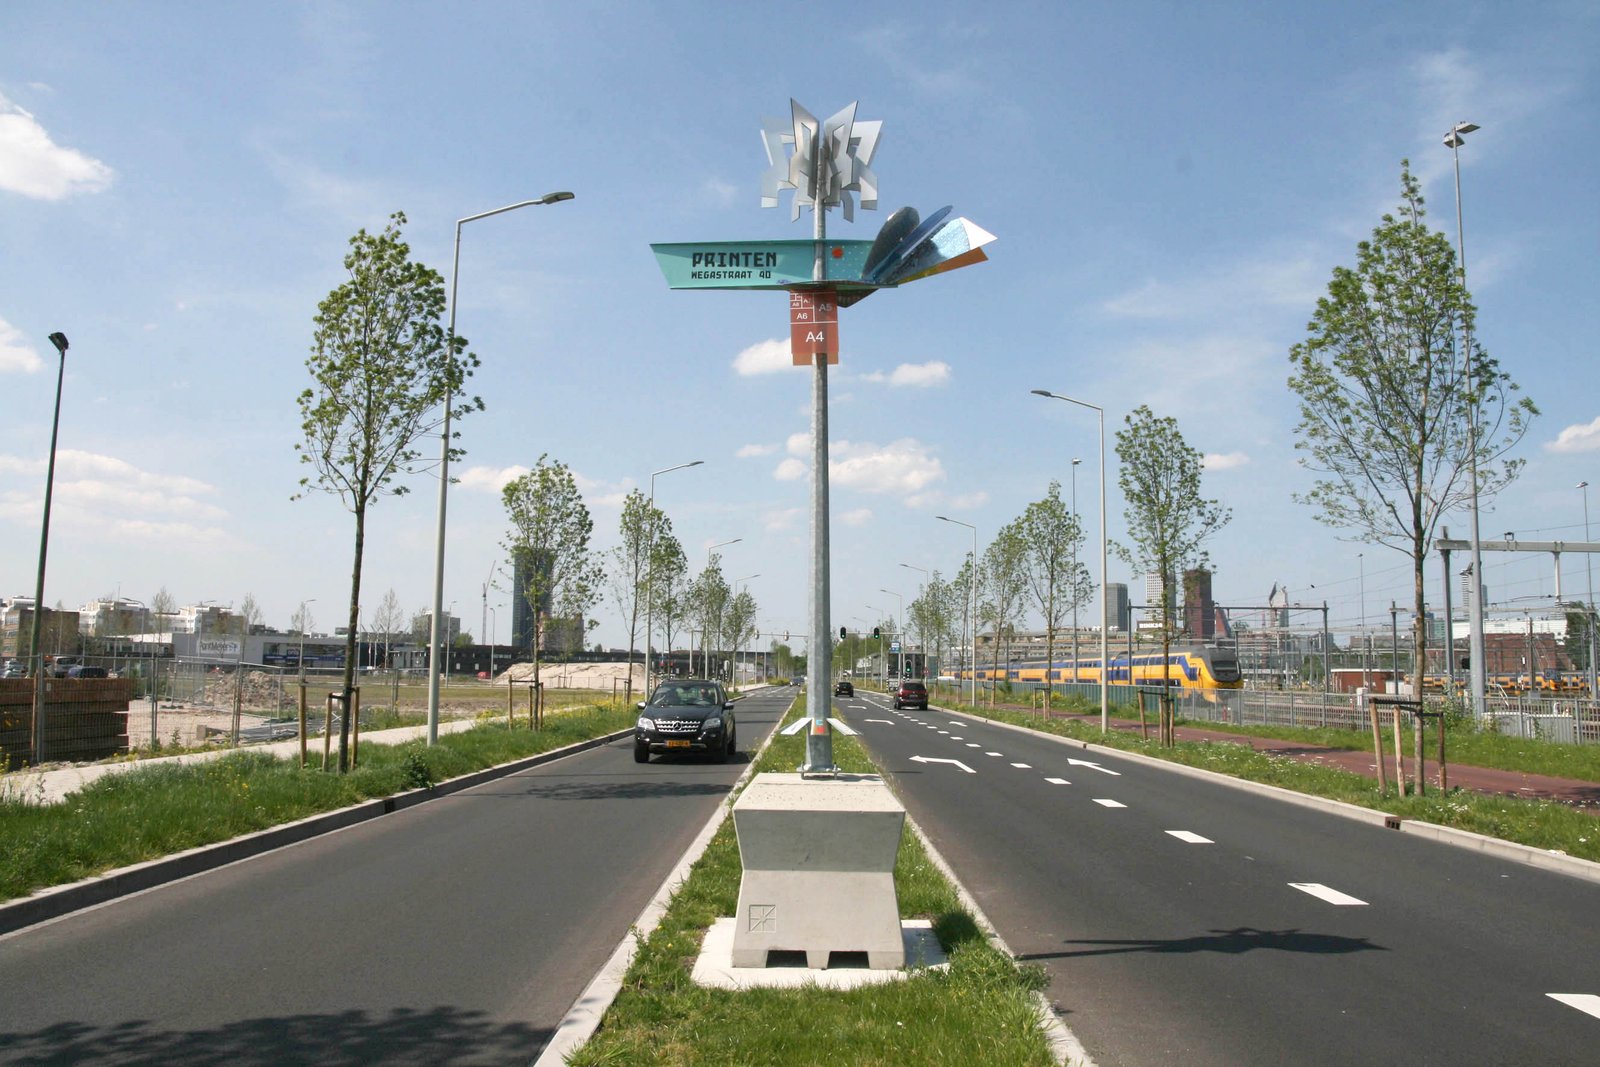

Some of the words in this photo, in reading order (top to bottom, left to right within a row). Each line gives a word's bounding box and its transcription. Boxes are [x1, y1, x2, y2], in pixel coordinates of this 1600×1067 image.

[692, 252, 776, 267] PRINTEN
[818, 304, 832, 312] A5
[805, 331, 825, 343] A4
